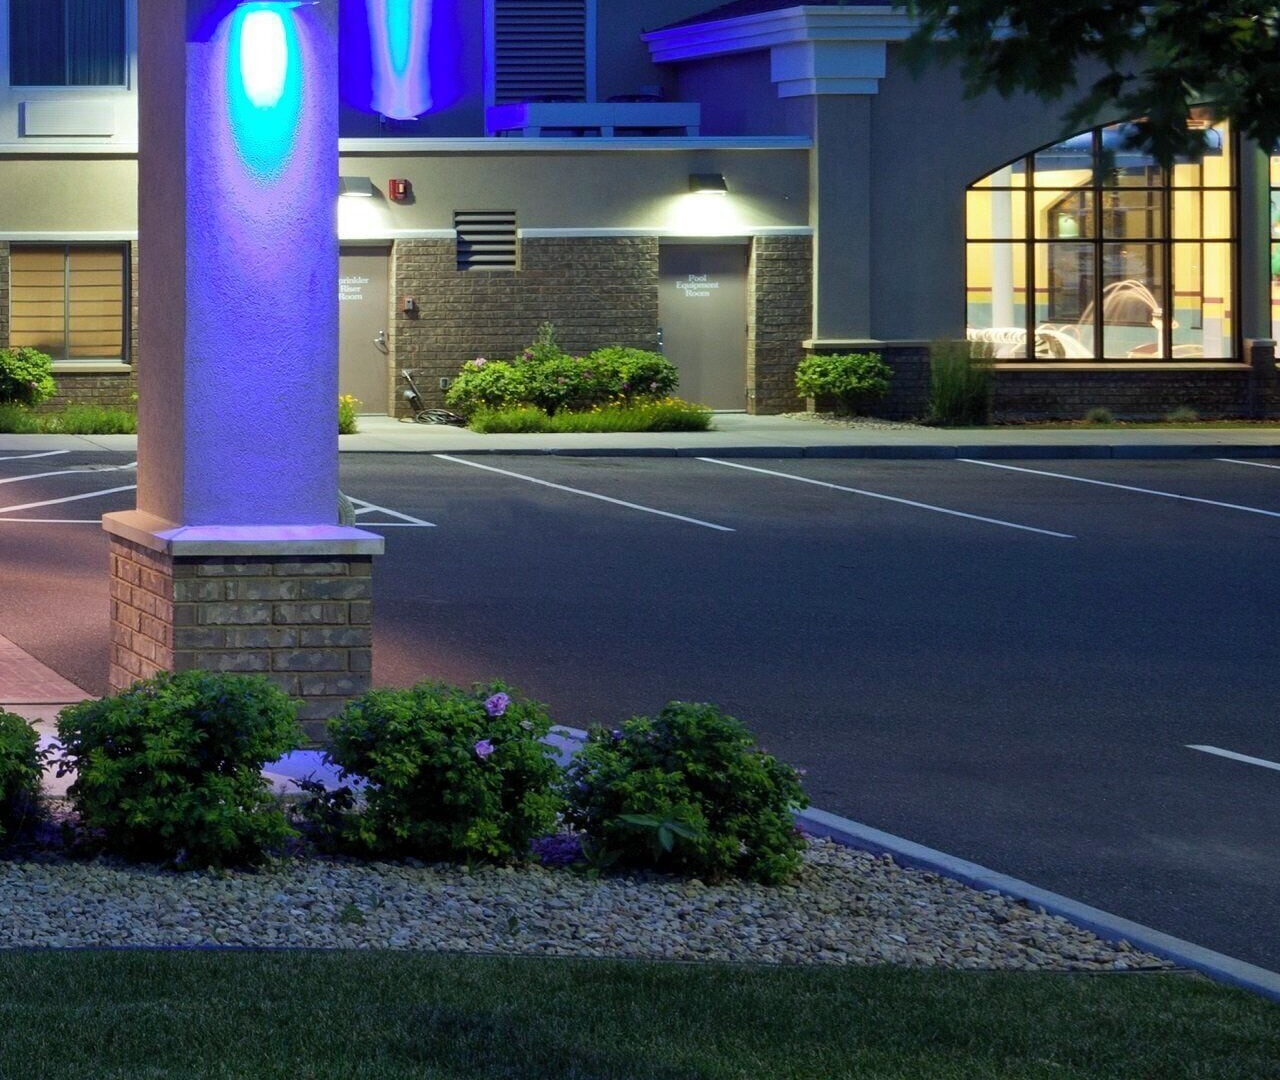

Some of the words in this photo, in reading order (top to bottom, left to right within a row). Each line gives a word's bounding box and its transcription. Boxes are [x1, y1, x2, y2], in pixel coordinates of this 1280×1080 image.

[338, 276, 369, 285] prinkler
[688, 274, 707, 282] Pool
[675, 281, 719, 290] Equipment
[338, 292, 363, 300] Room
[685, 289, 710, 297] Room
